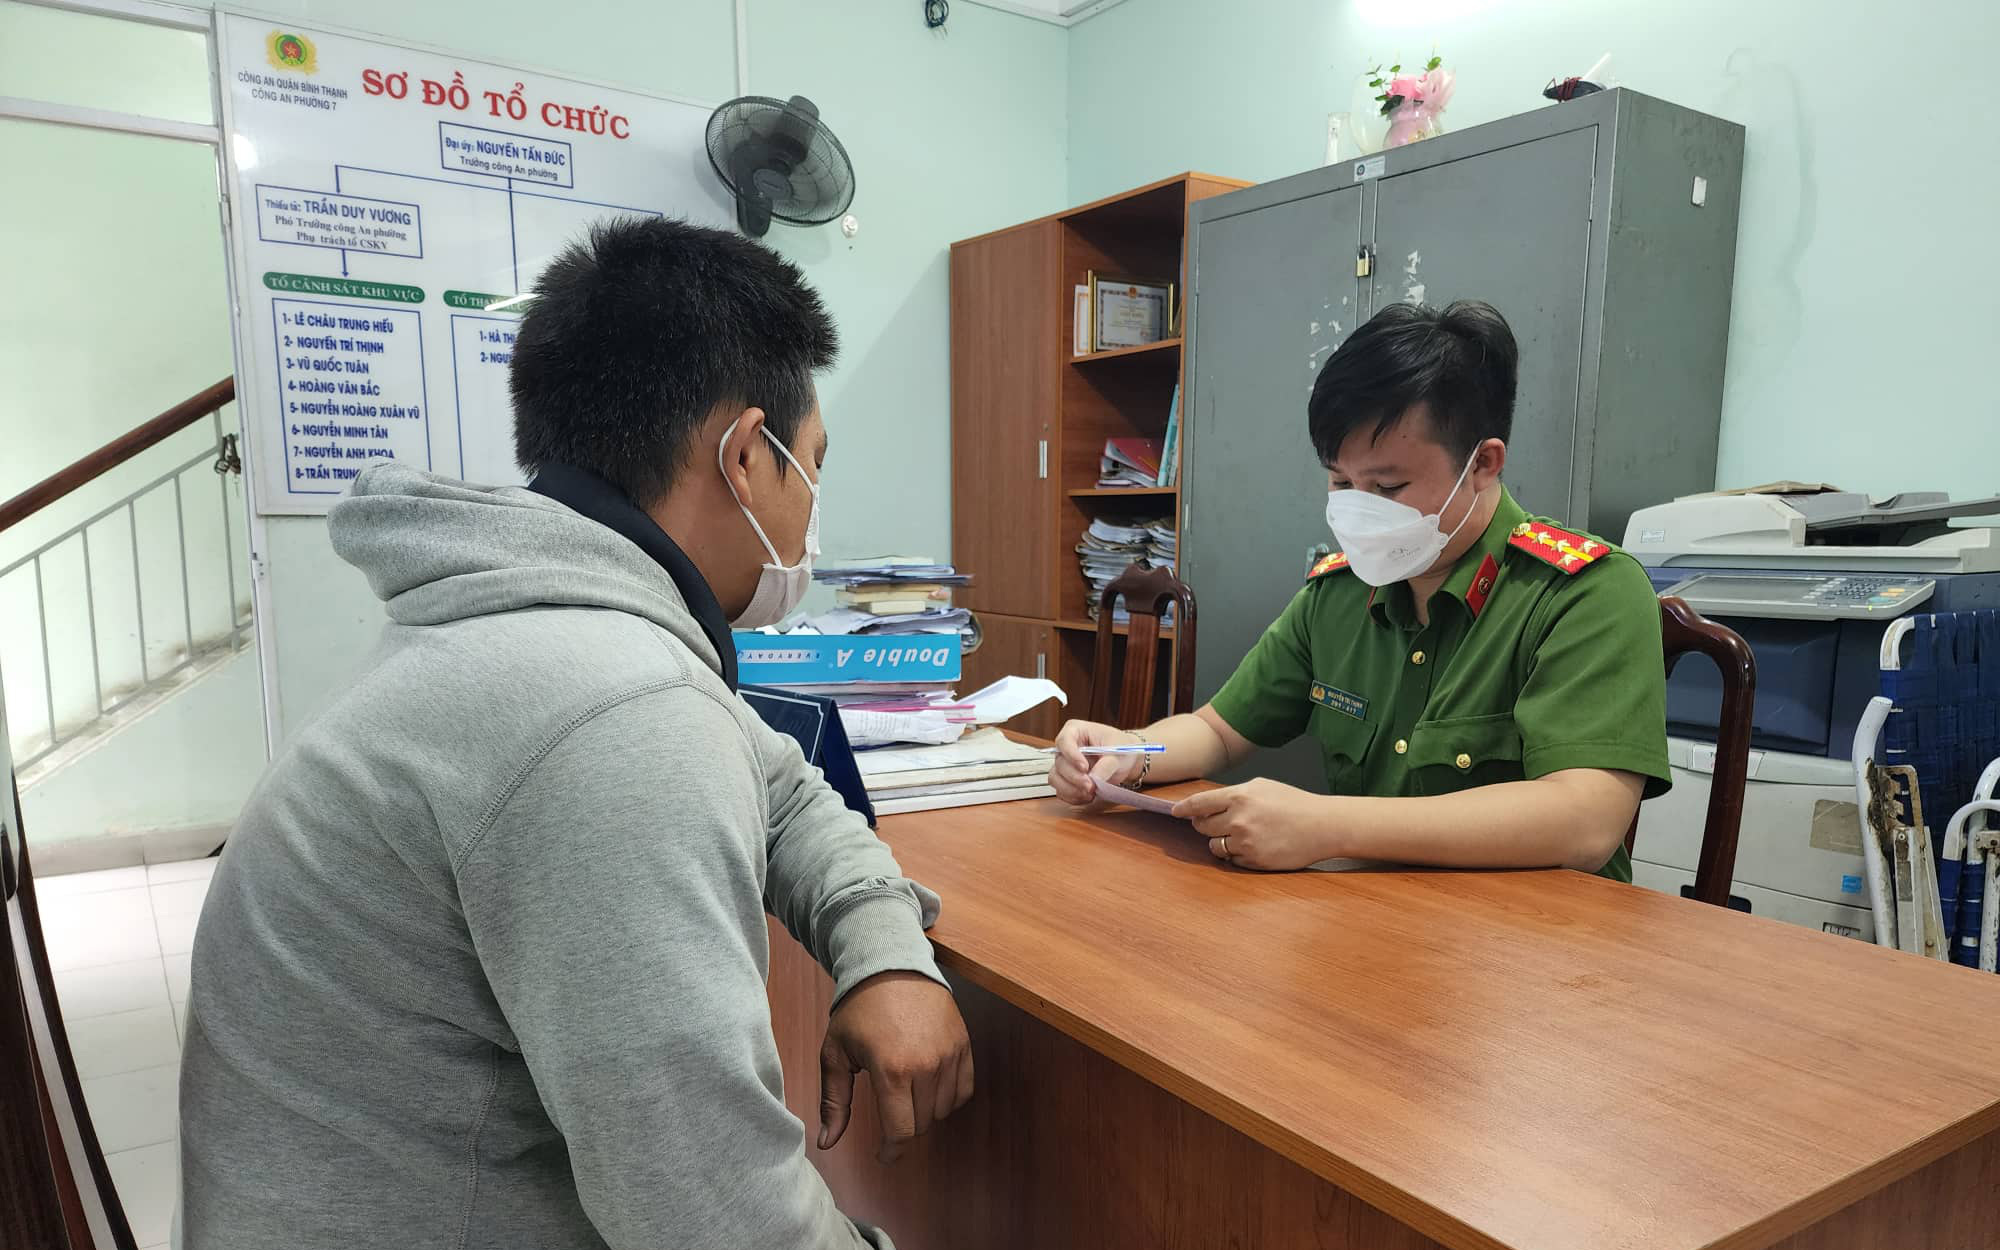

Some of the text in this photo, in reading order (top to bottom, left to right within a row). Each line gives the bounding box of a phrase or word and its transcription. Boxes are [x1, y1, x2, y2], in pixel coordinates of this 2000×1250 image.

[238, 70, 261, 85] CÔNG
[264, 76, 275, 87] AN
[251, 87, 277, 102] CÔNG
[280, 93, 292, 103] AN
[332, 101, 337, 111] 7
[361, 68, 630, 140] SƠ ĐỒ TỔ CHỨC
[445, 136, 460, 151] Đại
[476, 139, 520, 160] NGUYỄN
[544, 150, 566, 166] ĐỨC
[492, 161, 513, 174] công
[515, 165, 526, 174] An
[341, 204, 366, 220] DUY
[369, 207, 412, 226] VƯƠNG
[275, 215, 294, 226] Phó
[333, 223, 356, 235] công
[358, 225, 371, 236] An
[359, 238, 389, 250] CSKV
[333, 281, 359, 295] SÁT
[361, 286, 390, 298] KHU
[282, 312, 292, 324] 1-
[294, 311, 305, 326] LÊ
[307, 313, 336, 329] CHÂU
[338, 317, 370, 332] TRUNG
[479, 330, 487, 342] 1-
[488, 328, 501, 343] HÀ
[283, 335, 384, 356] 2- NGUYỄN TRÍ THỊNH
[286, 357, 295, 369] 3-
[313, 355, 343, 372] QUỐC
[480, 351, 488, 363] 2-
[288, 378, 381, 396] 4- HOÀNG VĂN BẮC
[290, 398, 420, 419] 5- NGUYỄN HOÀNG XUÂN VŨ
[291, 424, 301, 435] 6-
[302, 420, 341, 437] NGUYỄN
[343, 426, 368, 438] MINH
[293, 445, 303, 457] 7-
[304, 442, 343, 458] NGUYỄN
[345, 448, 366, 459] ANH
[295, 464, 358, 480] 8- TRẦN TRUN
[747, 652, 820, 660] EVERYDAY
[837, 647, 950, 668] Double A
